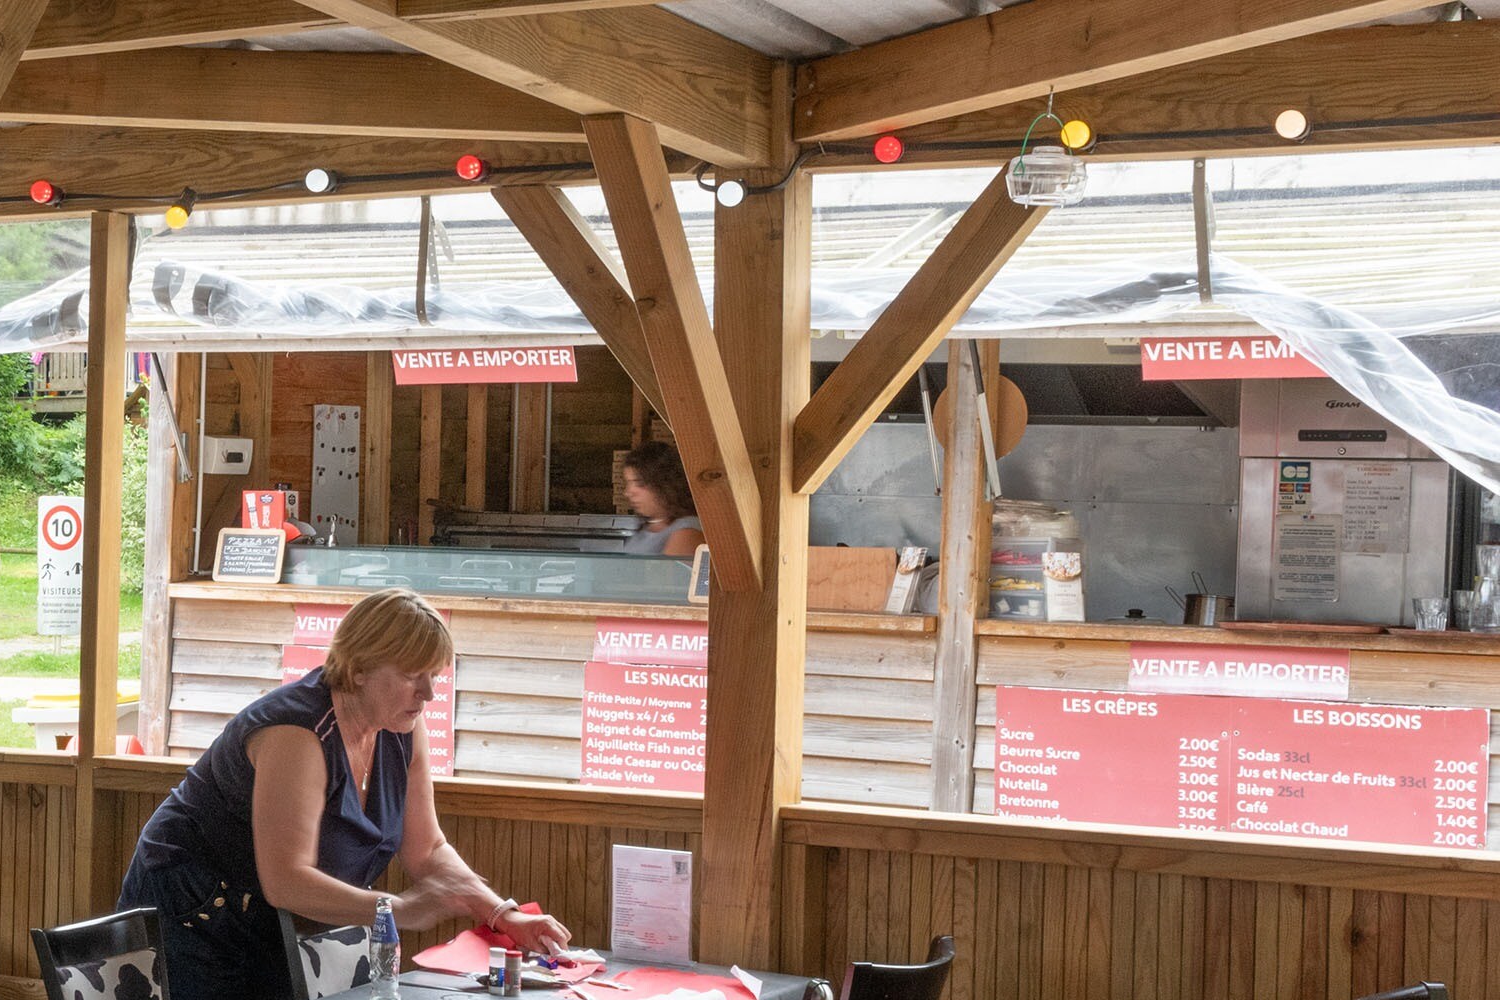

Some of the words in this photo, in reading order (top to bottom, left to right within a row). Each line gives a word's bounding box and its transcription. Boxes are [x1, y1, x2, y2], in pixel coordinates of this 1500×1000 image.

[395, 352, 453, 368] VENTE
[457, 353, 470, 367] A
[473, 350, 572, 366] EMPORTER
[1144, 342, 1223, 361] VENTE
[1228, 342, 1245, 359] A
[1325, 400, 1361, 409] GRAM
[52, 519, 73, 537] 10
[297, 616, 342, 631] VENT
[597, 632, 652, 649] VENTE
[655, 635, 668, 649] A
[672, 635, 708, 651] EMP
[625, 671, 647, 684] LES
[1132, 659, 1199, 677] VENTE
[1204, 661, 1218, 677] A
[1224, 662, 1346, 683] EMPORTER
[587, 692, 613, 703] Frite
[614, 694, 641, 706] Petite
[648, 697, 692, 713] Moyenne
[1063, 699, 1091, 713] LES
[1095, 698, 1158, 716] CRÊPES
[425, 711, 448, 720] 9.00€
[587, 707, 634, 723] Nuggets
[636, 711, 651, 721] x4
[660, 712, 675, 723] x6
[1293, 709, 1324, 725] LES
[1328, 711, 1421, 730] BOISSONS
[586, 722, 631, 737] Beignet
[632, 725, 646, 737] de
[648, 727, 706, 741] Camembe
[1000, 728, 1034, 741] Sucre
[1179, 738, 1219, 752] 2.00€
[586, 737, 645, 752] Aiguillette
[647, 742, 670, 754] Fish
[673, 745, 695, 756] and
[586, 752, 623, 766] Salade
[625, 755, 662, 768] Caesar
[664, 760, 679, 770] ou
[1000, 745, 1043, 758] Beurre
[1045, 747, 1080, 760] Sucre
[1179, 755, 1217, 768] 2.50€
[1237, 748, 1280, 763] Sodas
[1283, 751, 1311, 764] 33cl
[1434, 760, 1478, 774] 2.00€
[586, 768, 622, 781] Salade
[624, 770, 655, 784] Verte
[999, 761, 1057, 775] Chocolat
[1178, 772, 1218, 786] 3.00€
[1237, 766, 1260, 779] Jus
[1262, 768, 1277, 780] et
[1280, 768, 1329, 784] Nectar
[1331, 770, 1350, 784] de
[1353, 772, 1396, 787] Fruits
[1399, 776, 1427, 789] 33cl
[1433, 778, 1477, 793] 2.00€
[999, 778, 1048, 792] Nutella
[1178, 789, 1218, 803] 3.00€
[1237, 783, 1274, 797] Bière
[1277, 785, 1305, 798] 25cl
[1434, 796, 1477, 811] 2.50€
[999, 794, 1059, 809] Bretonne
[1177, 806, 1217, 820] 3.50€
[1237, 800, 1268, 814] Café
[1436, 813, 1478, 829] 1.40€
[1236, 817, 1299, 835] Chocolat
[1301, 821, 1348, 837] Chaud
[1433, 831, 1477, 847] 2.00€
